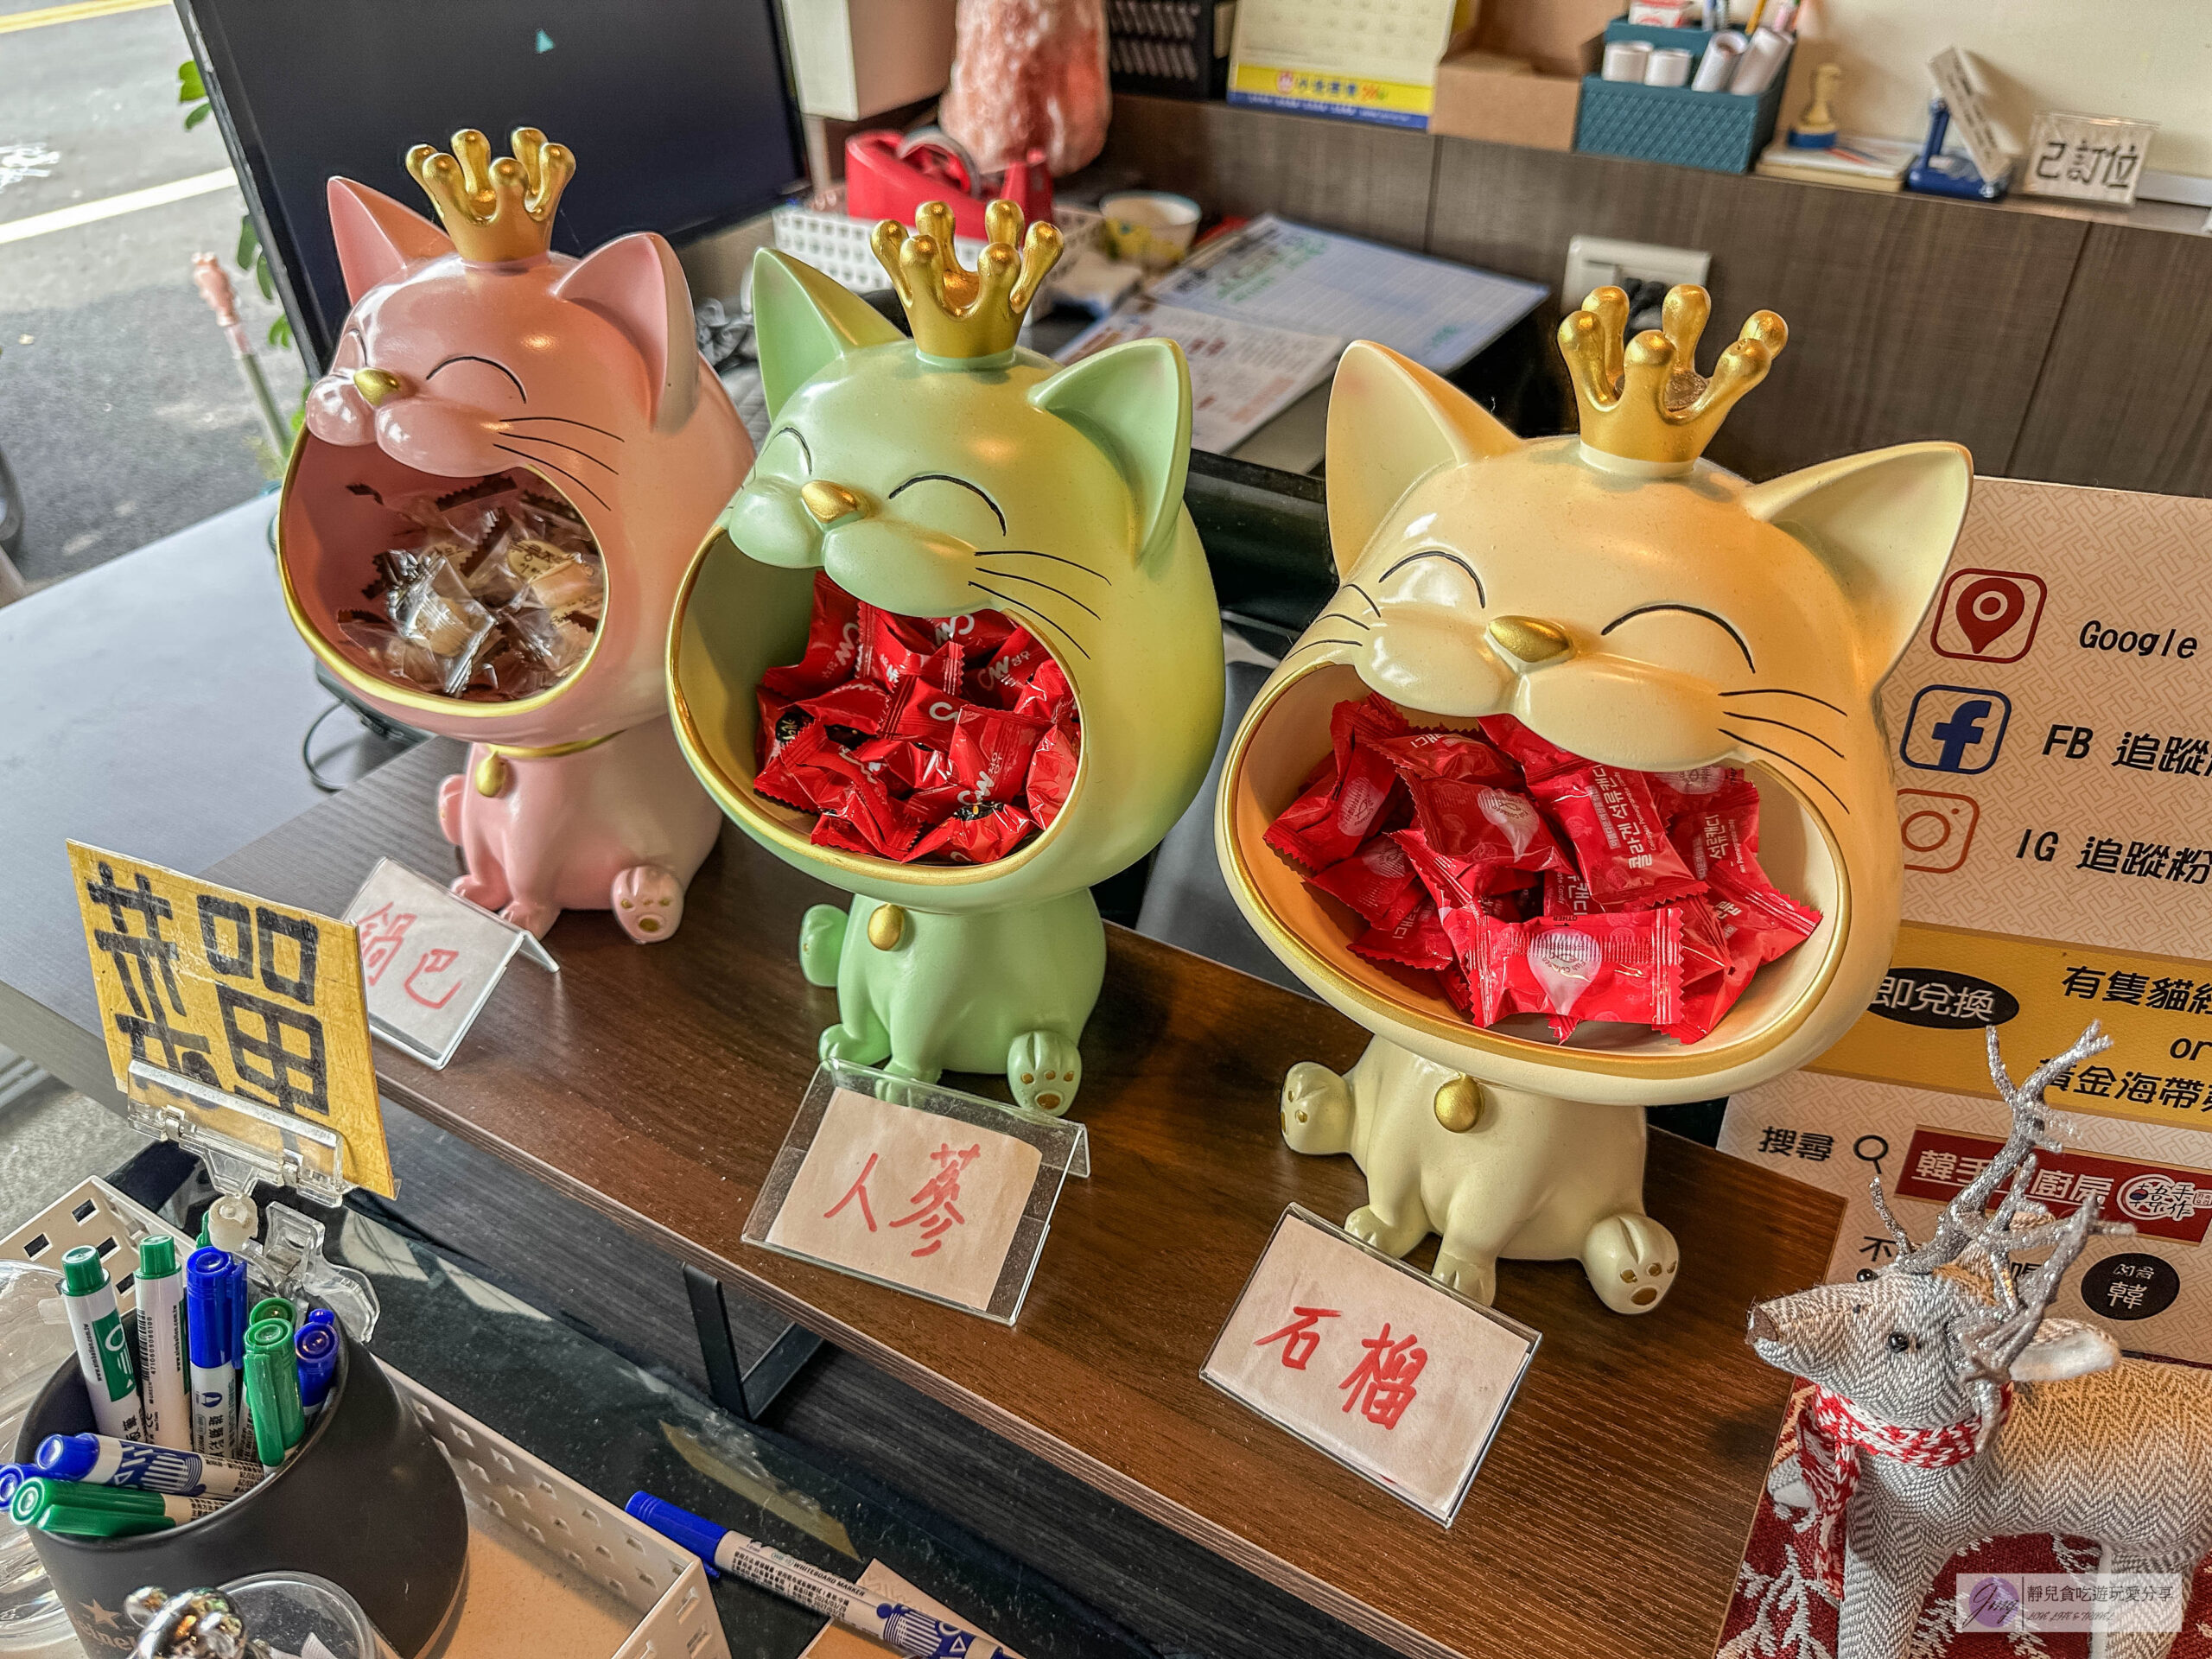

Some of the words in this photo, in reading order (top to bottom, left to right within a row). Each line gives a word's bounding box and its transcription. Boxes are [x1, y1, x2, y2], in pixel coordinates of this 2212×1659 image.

[2079, 620, 2197, 659] Google
[2042, 724, 2094, 759] FB
[2111, 732, 2212, 776] 追蹤
[1618, 822, 1652, 869] 콜라겐
[2016, 829, 2059, 861] IG
[1758, 1126, 1834, 1163] 搜尋
[1915, 1149, 2113, 1208] 韓手廚房
[1254, 1305, 1428, 1432] 石榴
[793, 1561, 836, 1584] WHITEBOARD
[836, 1580, 866, 1597] MARKER
